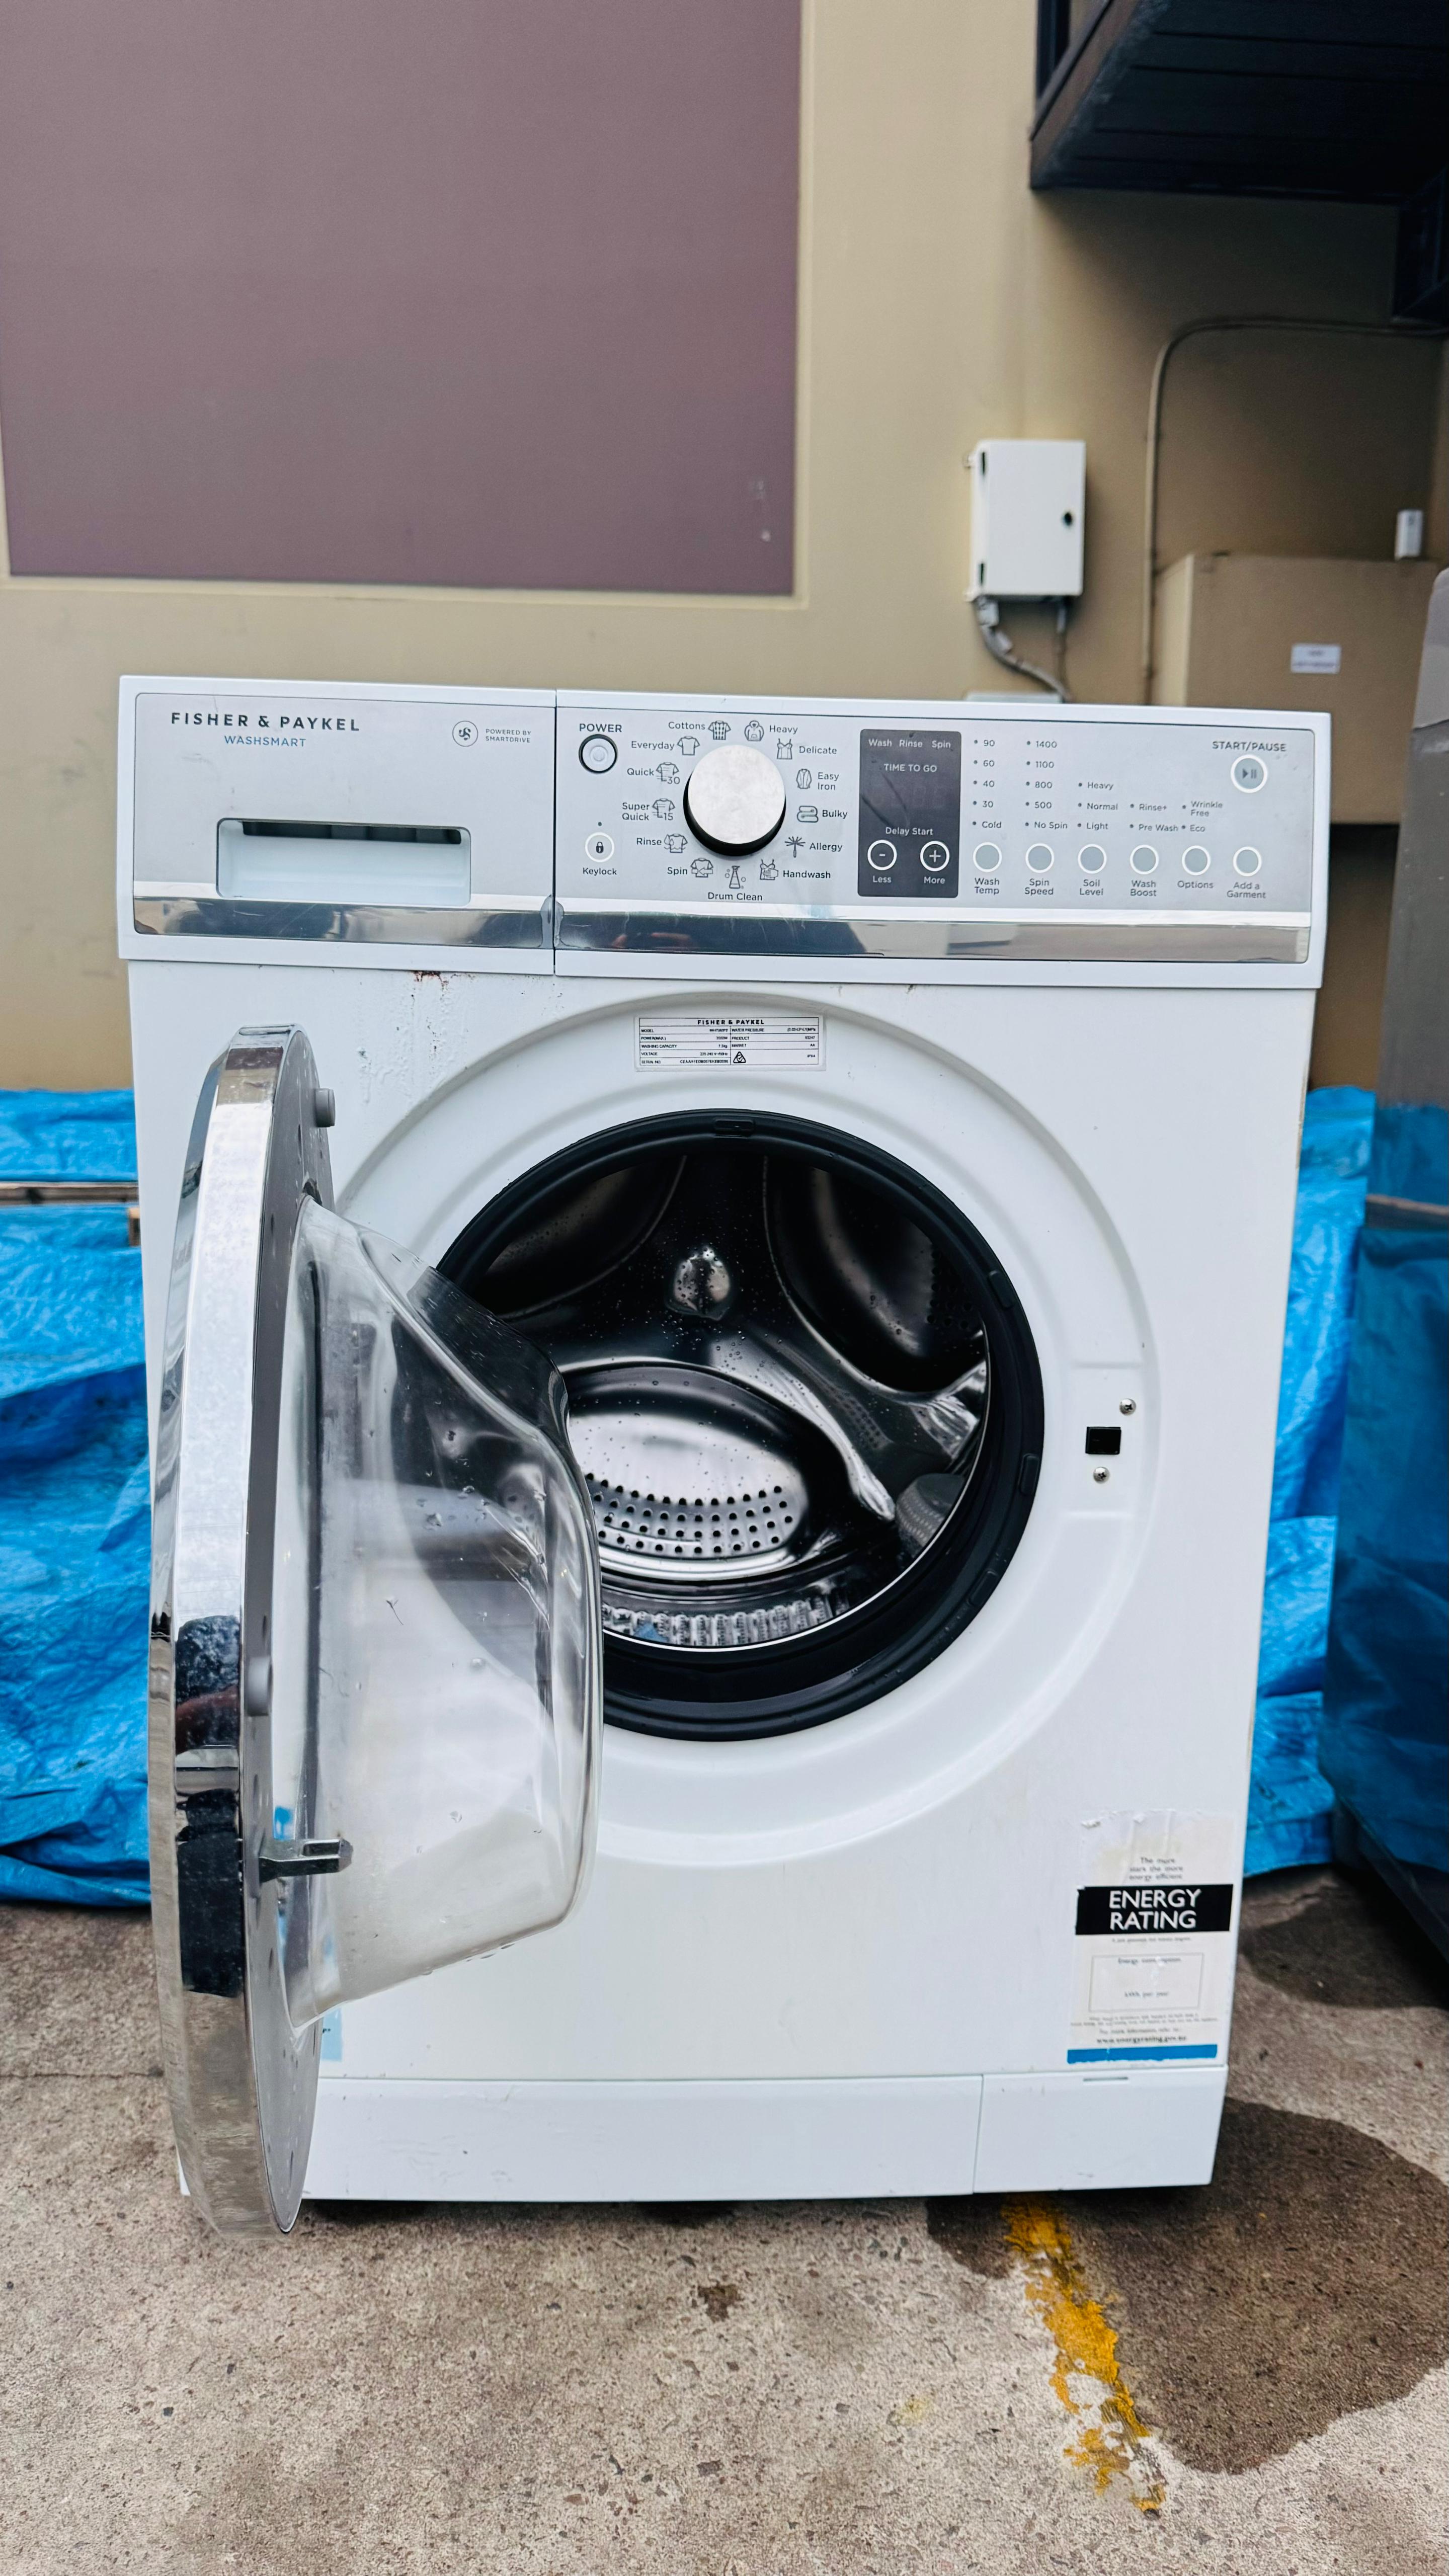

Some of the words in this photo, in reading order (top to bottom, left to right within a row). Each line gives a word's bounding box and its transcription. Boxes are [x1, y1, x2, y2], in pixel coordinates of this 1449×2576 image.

[172, 712, 248, 727] FISHER
[259, 715, 269, 728] &
[281, 716, 359, 731] PAYKEL
[669, 721, 705, 730] Cottons
[580, 723, 622, 732] POWER
[770, 725, 797, 735] Heavy
[224, 736, 306, 747] WASHSMART
[631, 741, 674, 751] Everyday
[868, 739, 892, 747] Wash
[932, 740, 951, 749] Spin
[799, 746, 837, 754] Delicate
[1213, 741, 1286, 752] START/PAUSE
[667, 776, 680, 784] 30
[818, 772, 839, 781] Easy
[1088, 782, 1113, 790] Heavy
[622, 802, 650, 811] Super
[664, 813, 673, 821] 15
[823, 810, 847, 819] Bulky
[886, 827, 909, 836] Delay
[1087, 823, 1108, 831] Light
[810, 843, 842, 852] Allergy
[583, 868, 616, 876] Keylock
[668, 867, 687, 875] Spin
[783, 870, 830, 878] Handwash
[1029, 878, 1049, 887] Spin
[1177, 880, 1214, 889] Options
[975, 887, 999, 895] Temp
[1025, 887, 1054, 896] Speed
[1227, 891, 1266, 899] Garment
[1109, 1889, 1201, 1908] ENERGY
[1110, 1910, 1196, 1930] RATING
